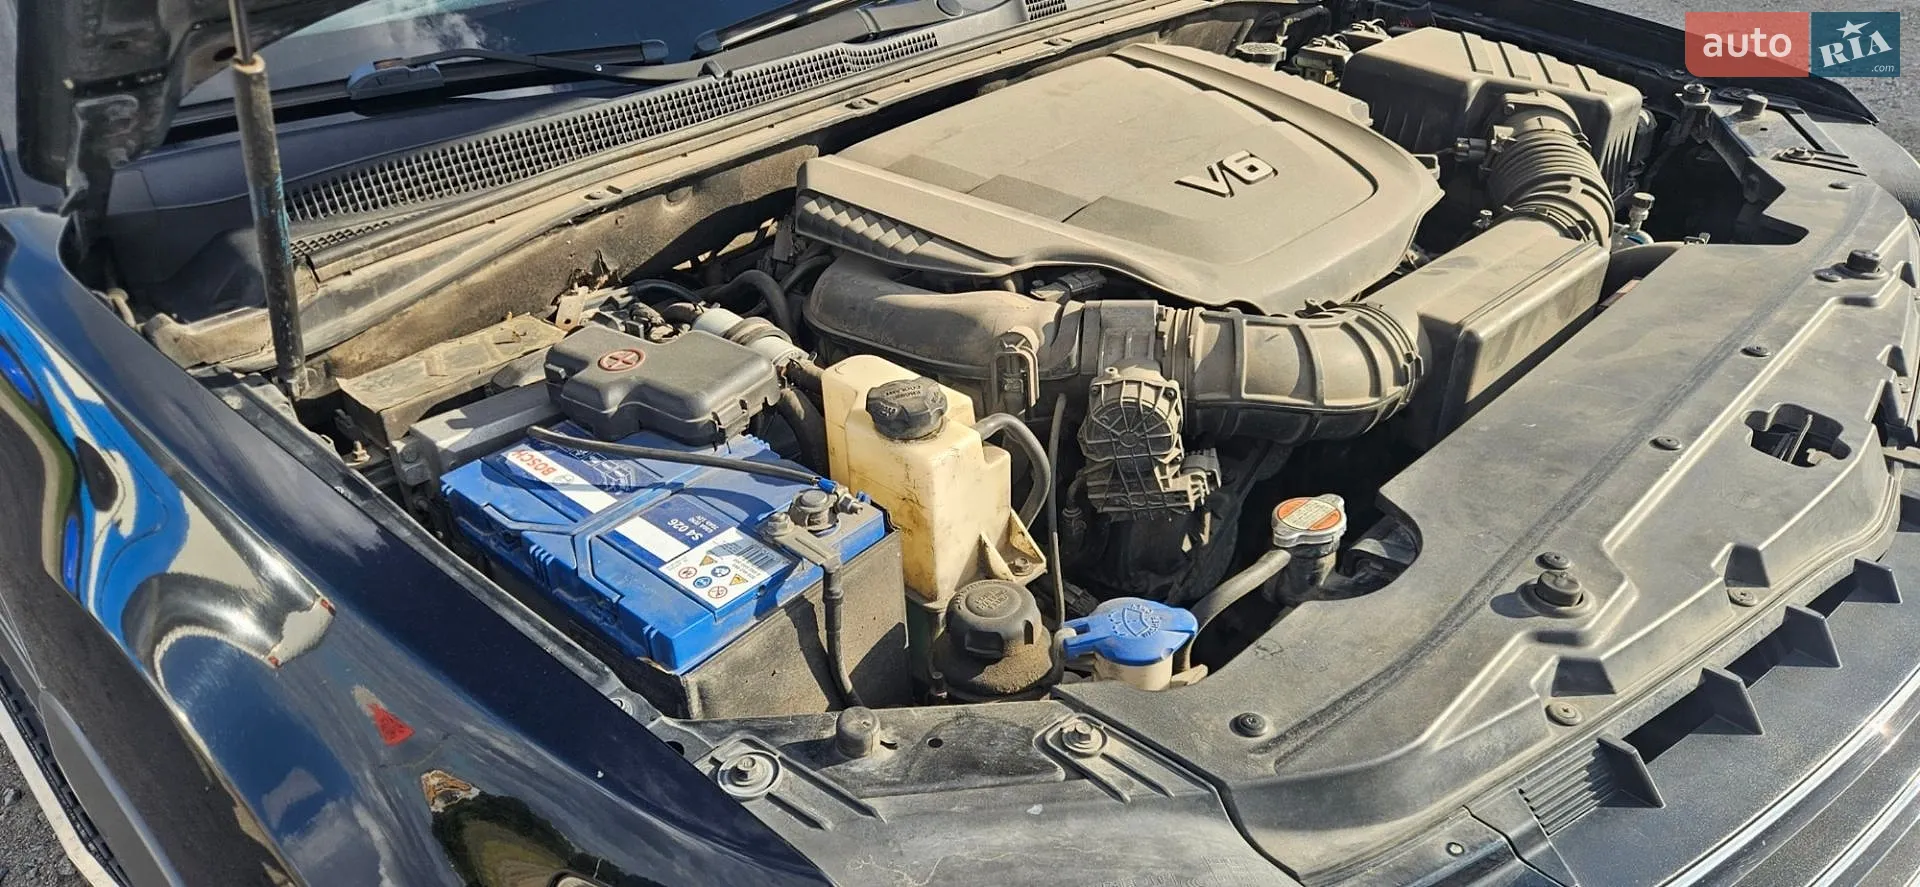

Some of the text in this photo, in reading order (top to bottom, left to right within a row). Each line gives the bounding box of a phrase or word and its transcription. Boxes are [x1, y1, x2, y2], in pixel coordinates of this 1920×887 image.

[1174, 149, 1278, 198] V6
[511, 449, 557, 476] BOSCH
[667, 518, 703, 541] S4 026
